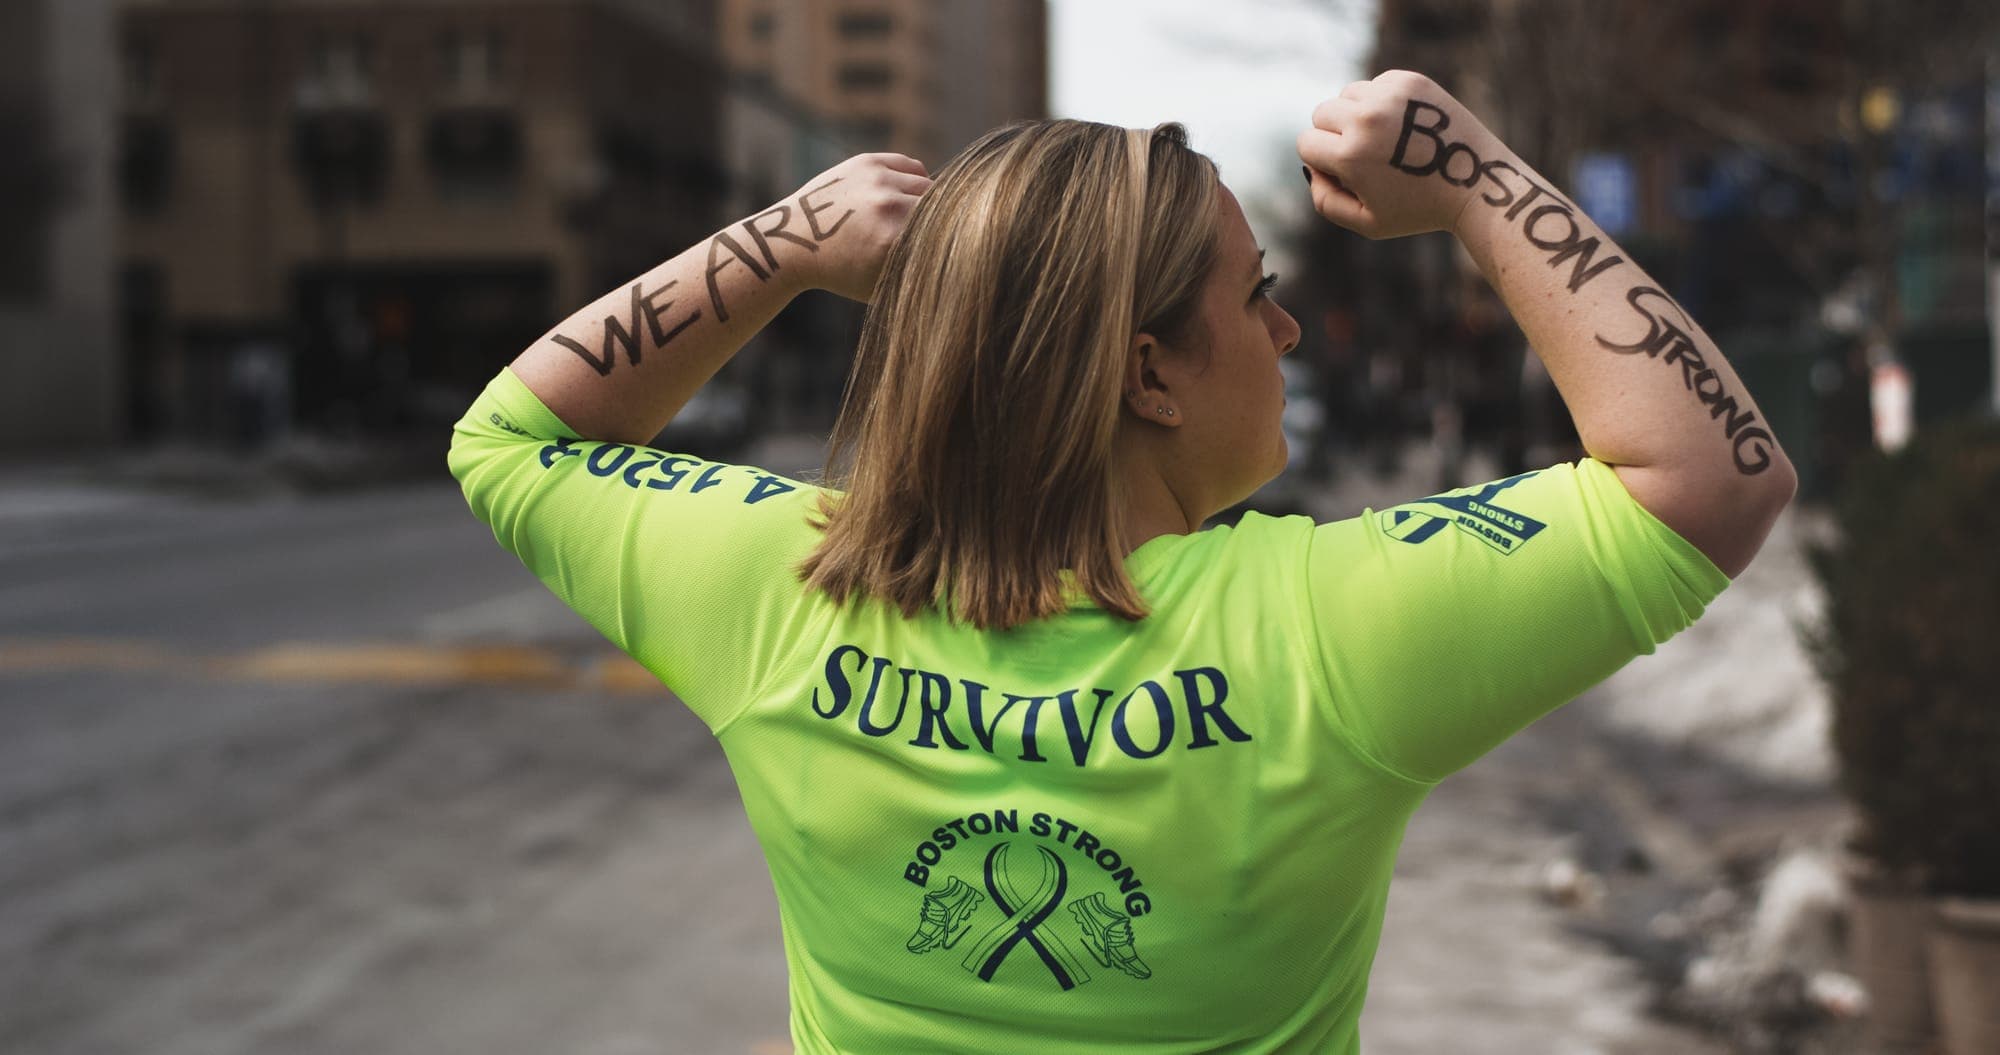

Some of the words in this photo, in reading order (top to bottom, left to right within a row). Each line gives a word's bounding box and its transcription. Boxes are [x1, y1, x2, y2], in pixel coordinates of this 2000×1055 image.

[551, 281, 701, 377] WE
[705, 177, 856, 323] ARE
[1389, 99, 1623, 294] BOSTON
[1595, 286, 1774, 476] STRONG
[1456, 515, 1513, 549] BOSTON
[1468, 501, 1525, 532] STRONG
[812, 644, 1253, 767] SURVIVOR
[904, 809, 1019, 888] BOSTON
[1029, 812, 1152, 917] STRONG
